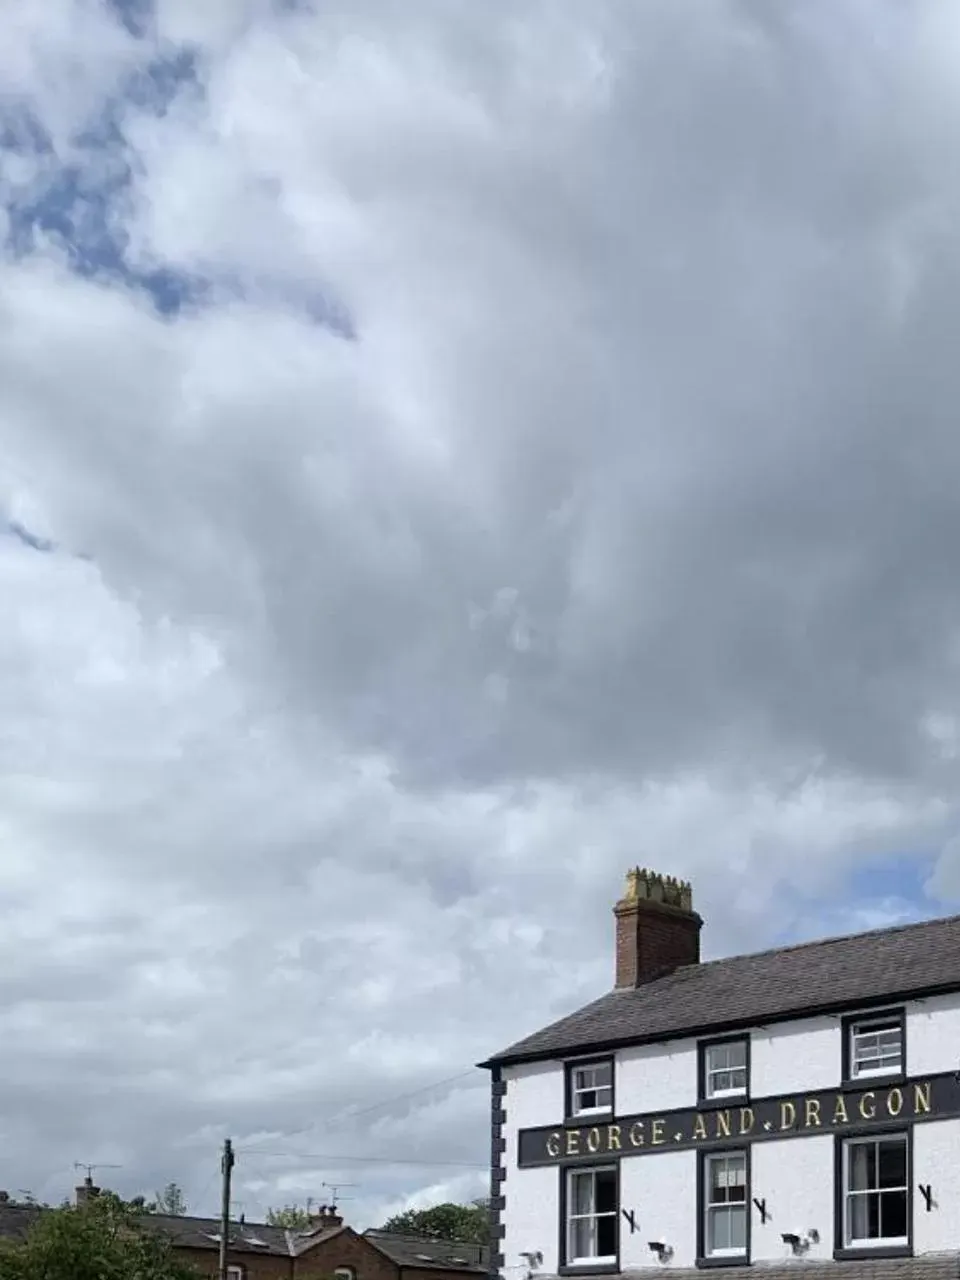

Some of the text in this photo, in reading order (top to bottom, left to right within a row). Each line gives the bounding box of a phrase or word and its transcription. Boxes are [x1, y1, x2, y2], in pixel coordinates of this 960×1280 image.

[545, 1082, 933, 1157] GEORGE AND DRAGON
